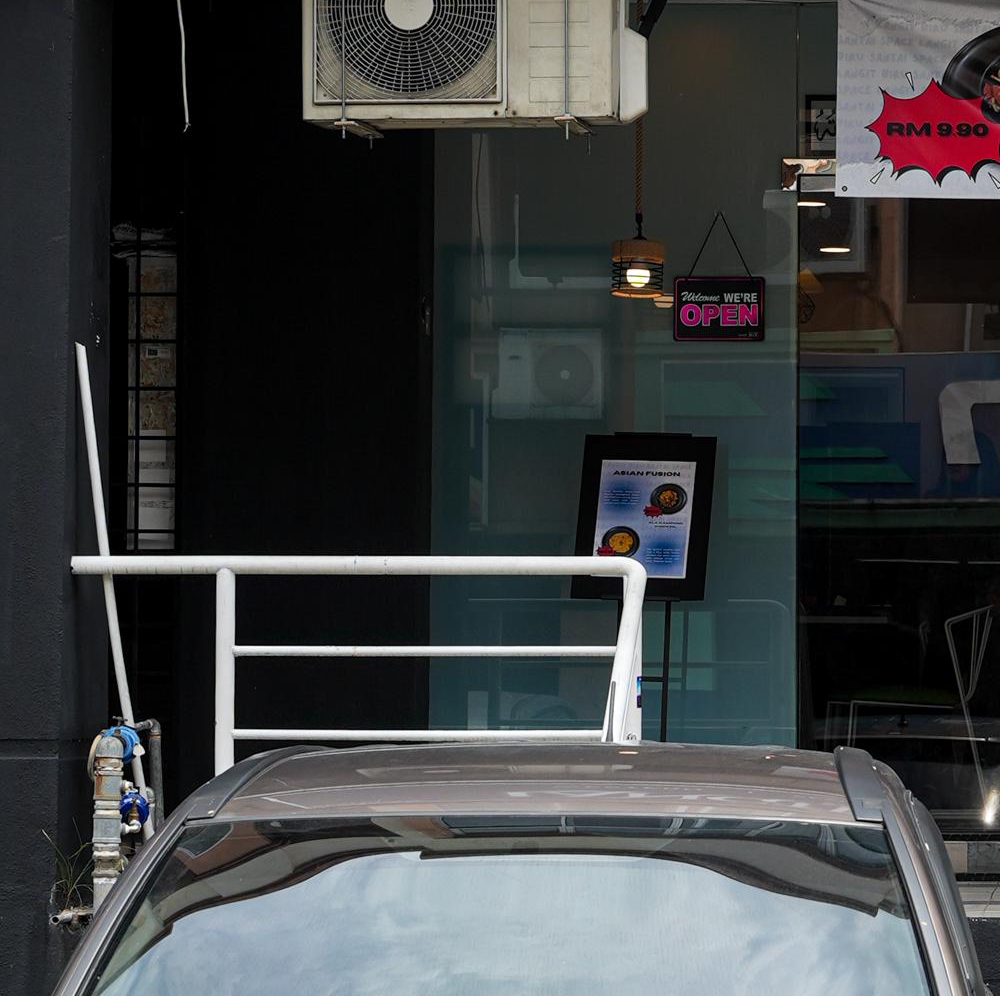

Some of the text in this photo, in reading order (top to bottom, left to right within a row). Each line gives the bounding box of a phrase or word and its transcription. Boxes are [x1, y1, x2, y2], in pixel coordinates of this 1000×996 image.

[886, 122, 989, 137] RM 9.90
[680, 291, 758, 303] Welcome WE'RE
[680, 303, 758, 327] OPEN
